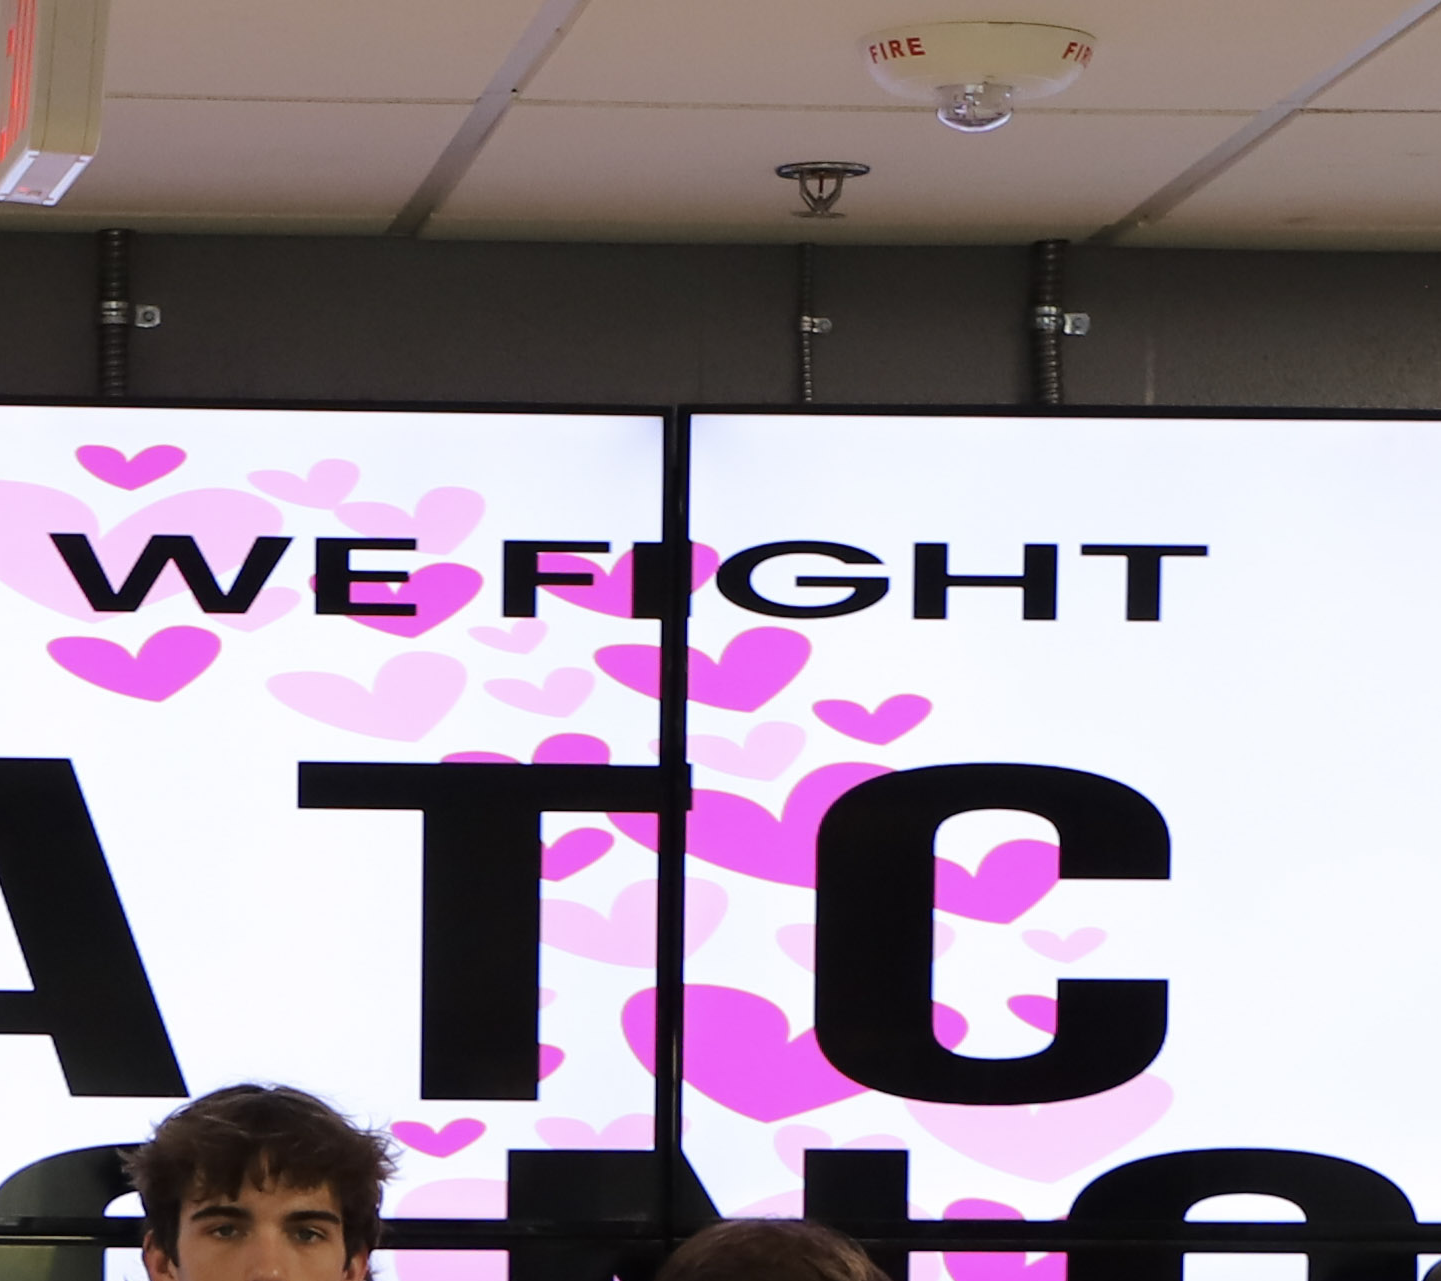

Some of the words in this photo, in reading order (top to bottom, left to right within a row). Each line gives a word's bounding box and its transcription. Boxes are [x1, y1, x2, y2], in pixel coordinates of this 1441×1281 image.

[869, 37, 926, 64] FIRE
[48, 531, 420, 616] WE
[501, 539, 1209, 622] FIGHT
